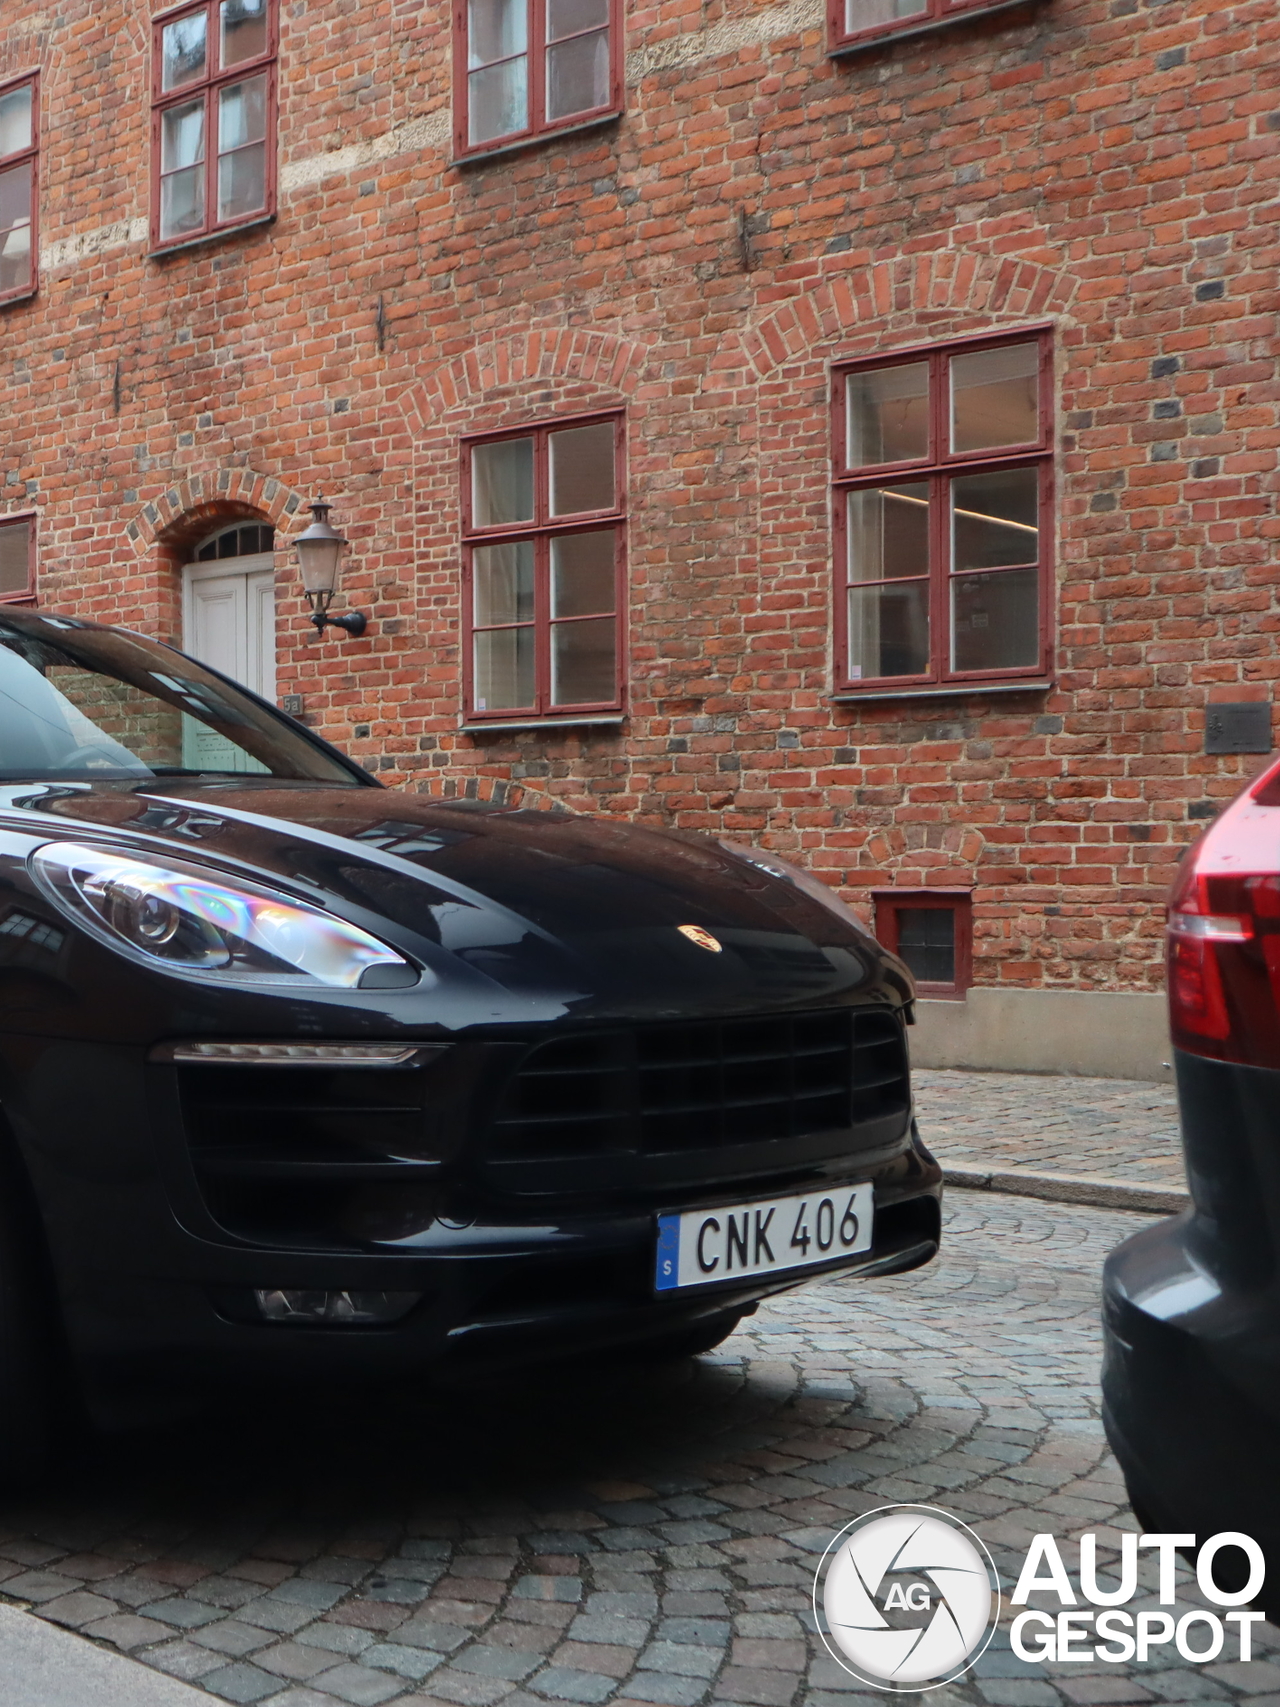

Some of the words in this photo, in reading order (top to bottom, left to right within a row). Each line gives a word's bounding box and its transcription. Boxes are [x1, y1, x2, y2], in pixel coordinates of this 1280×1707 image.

[284, 697, 299, 712] 5a
[696, 1206, 777, 1273] CNK
[790, 1192, 860, 1257] 406
[662, 1259, 673, 1277] S
